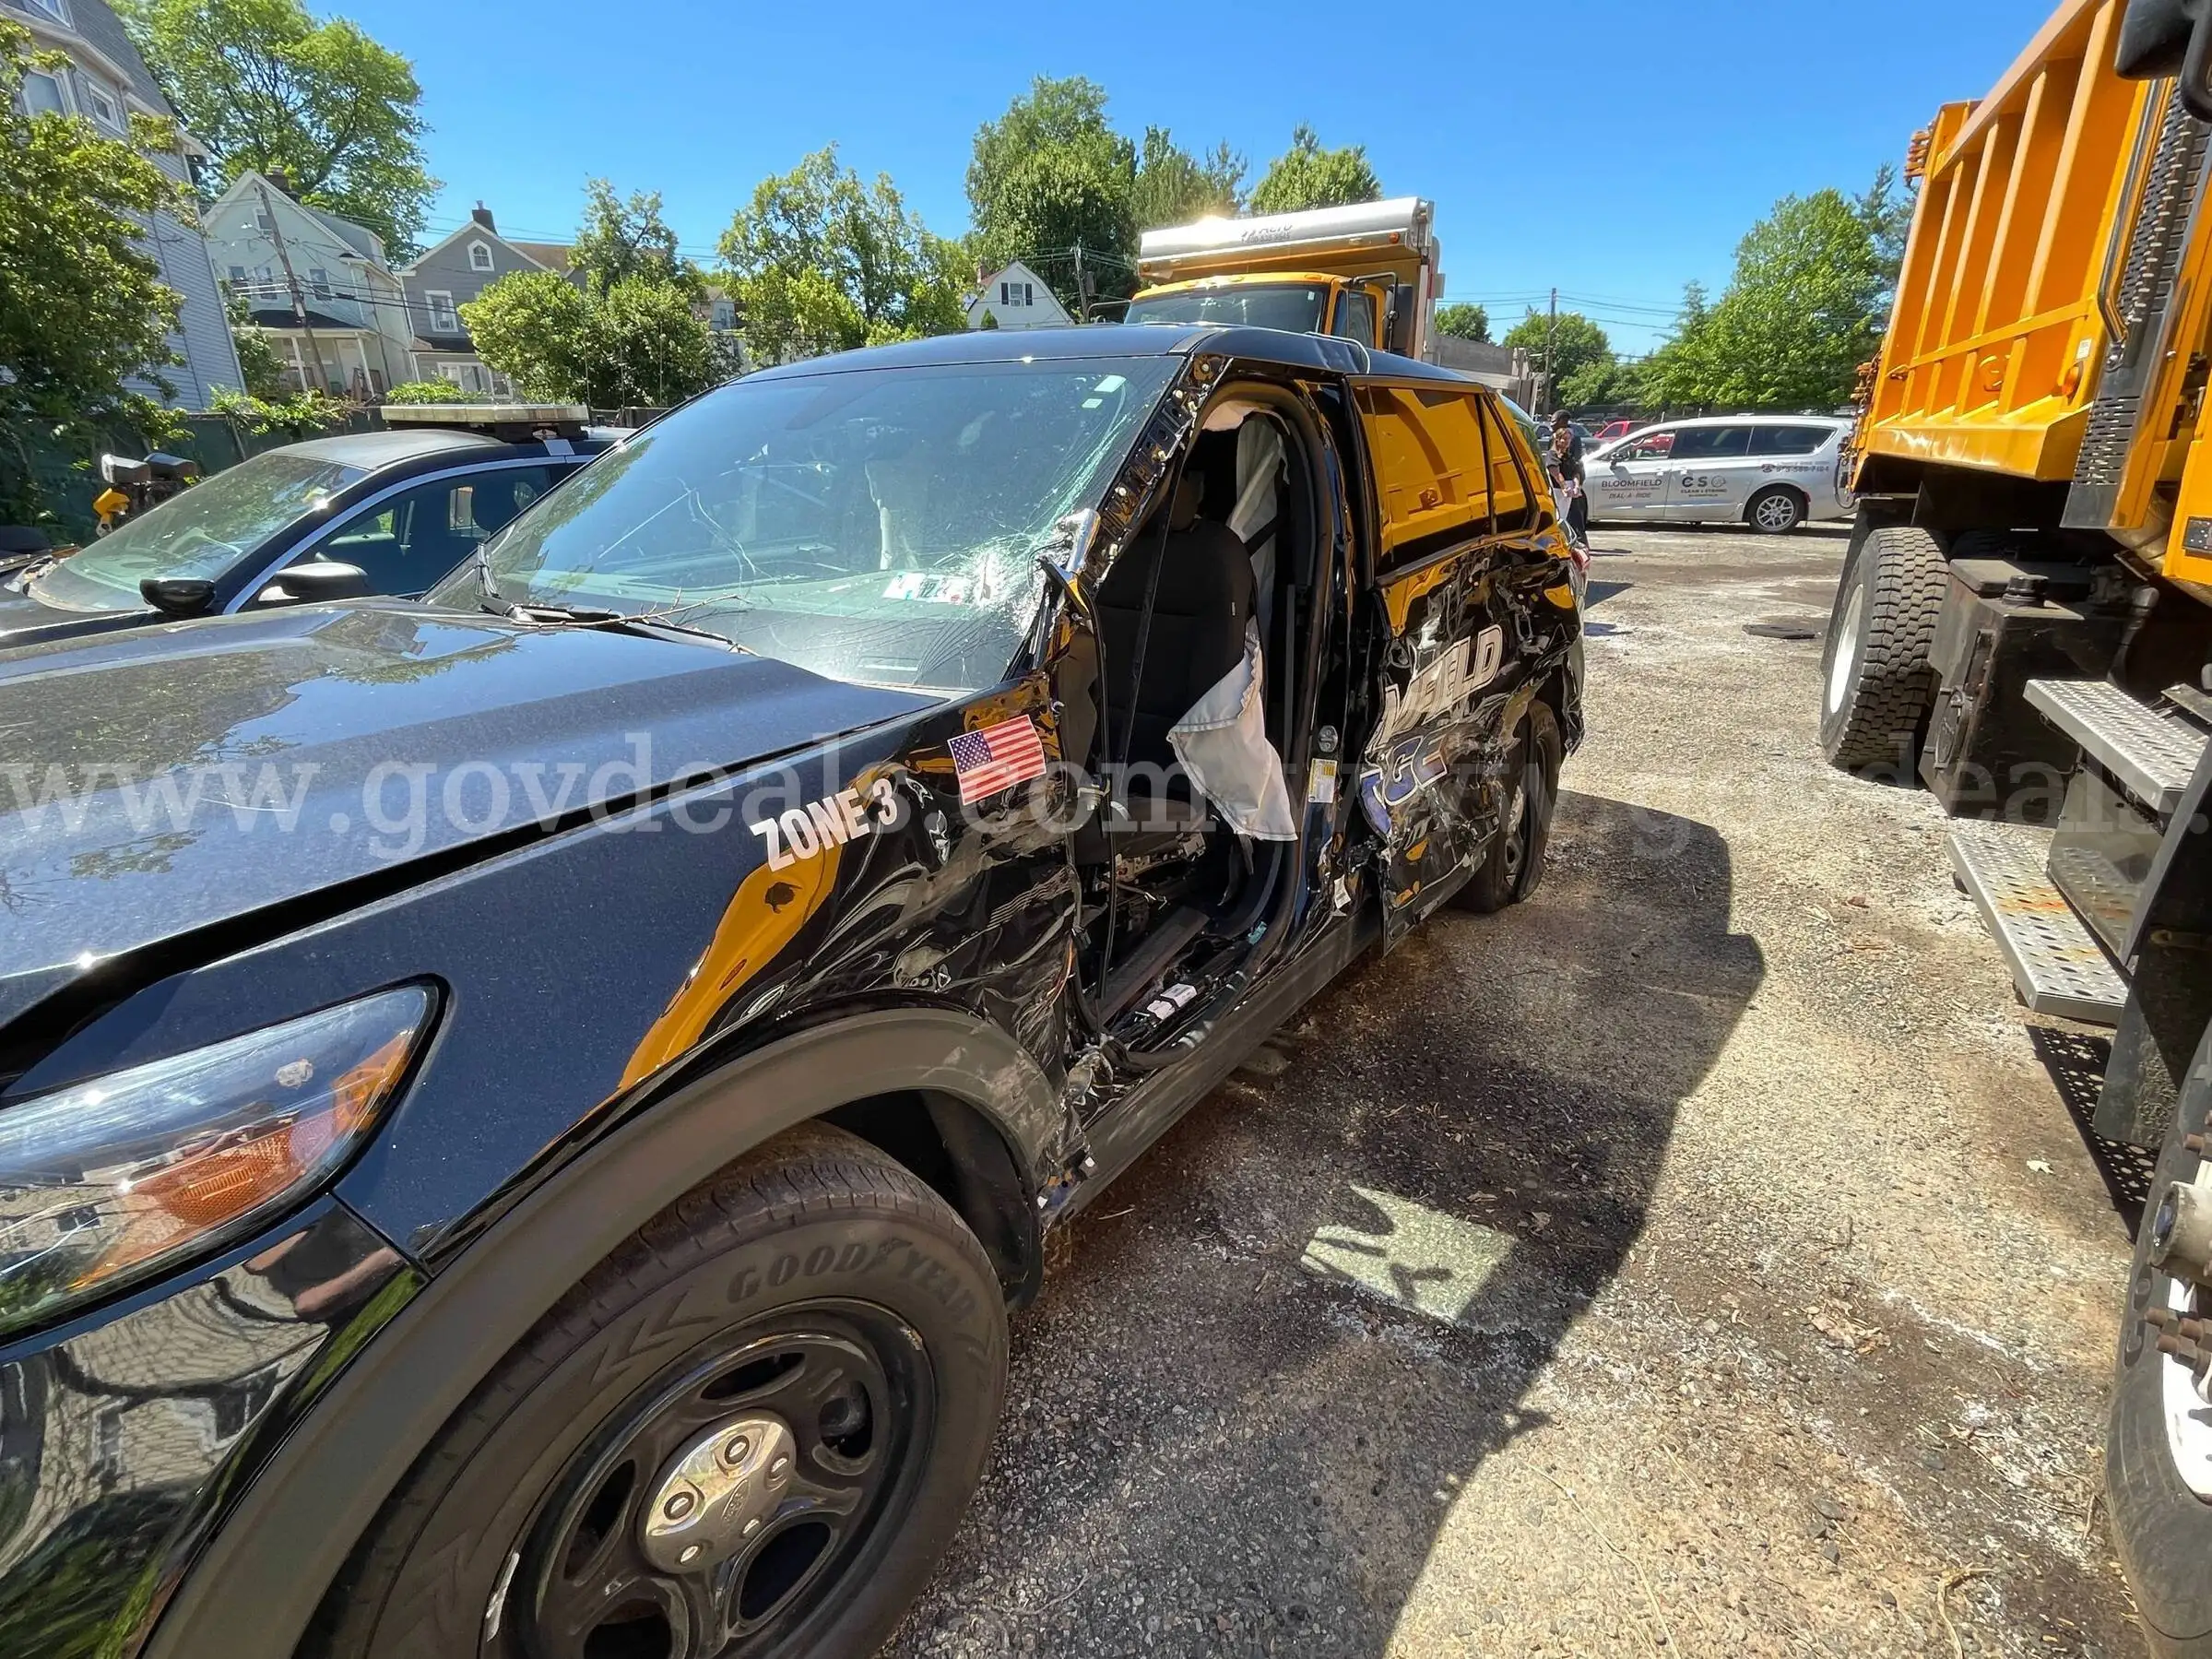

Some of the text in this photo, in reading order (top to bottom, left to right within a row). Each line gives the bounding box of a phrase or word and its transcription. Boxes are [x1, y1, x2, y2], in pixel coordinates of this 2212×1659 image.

[1602, 479, 1662, 488] BLOOMFIELD
[750, 778, 898, 872] ZONE 3
[726, 1237, 977, 1321] GOODYEAR
